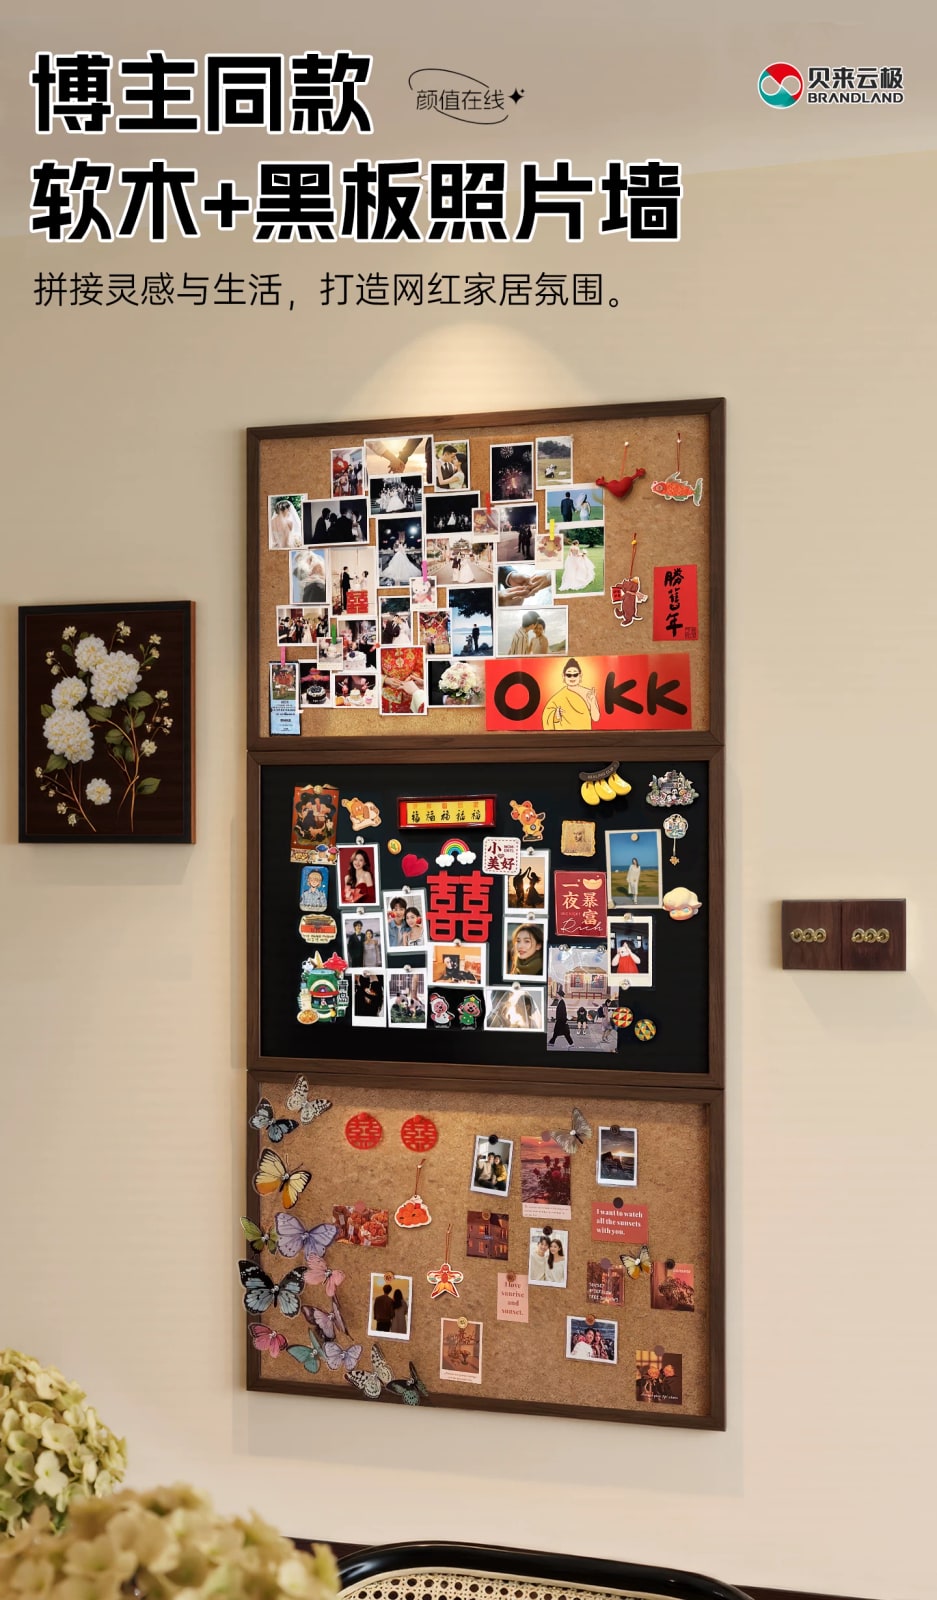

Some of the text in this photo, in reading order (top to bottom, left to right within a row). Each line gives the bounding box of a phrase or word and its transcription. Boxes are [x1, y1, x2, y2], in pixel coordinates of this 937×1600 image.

[624, 1211, 643, 1219] watch
[596, 1217, 641, 1228] all the sunsets
[501, 1290, 525, 1298] sunrise
[507, 1299, 520, 1307] and
